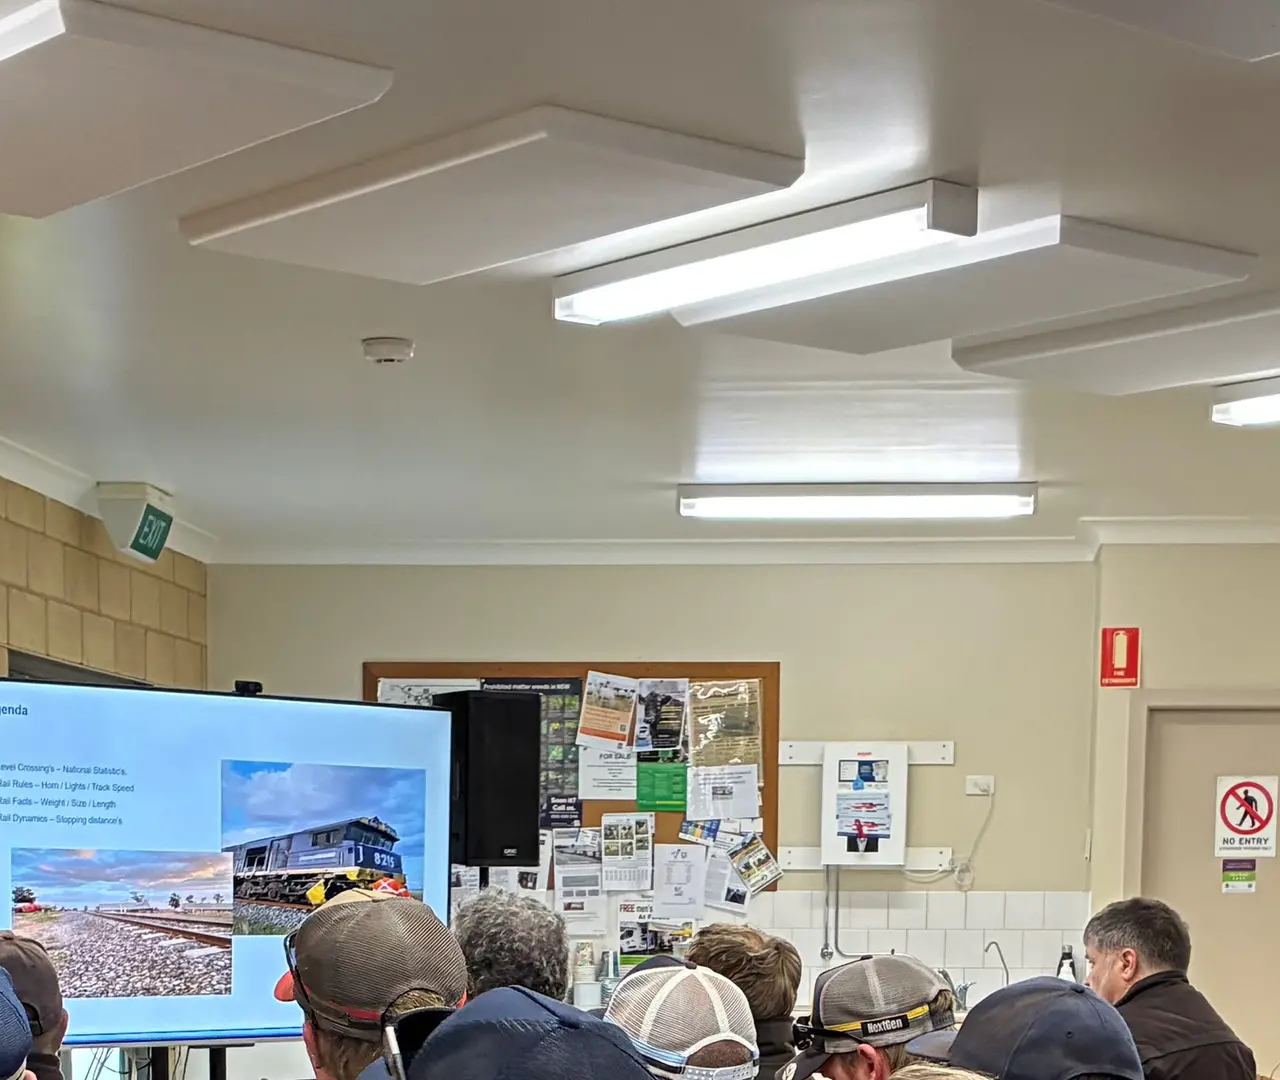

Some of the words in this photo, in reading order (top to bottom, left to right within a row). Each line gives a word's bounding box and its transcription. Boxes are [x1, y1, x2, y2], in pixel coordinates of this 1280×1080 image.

[138, 514, 167, 550] EXIT
[1222, 837, 1235, 845] NO
[1239, 837, 1269, 845] ENTRY
[867, 1018, 903, 1034] NextGen
